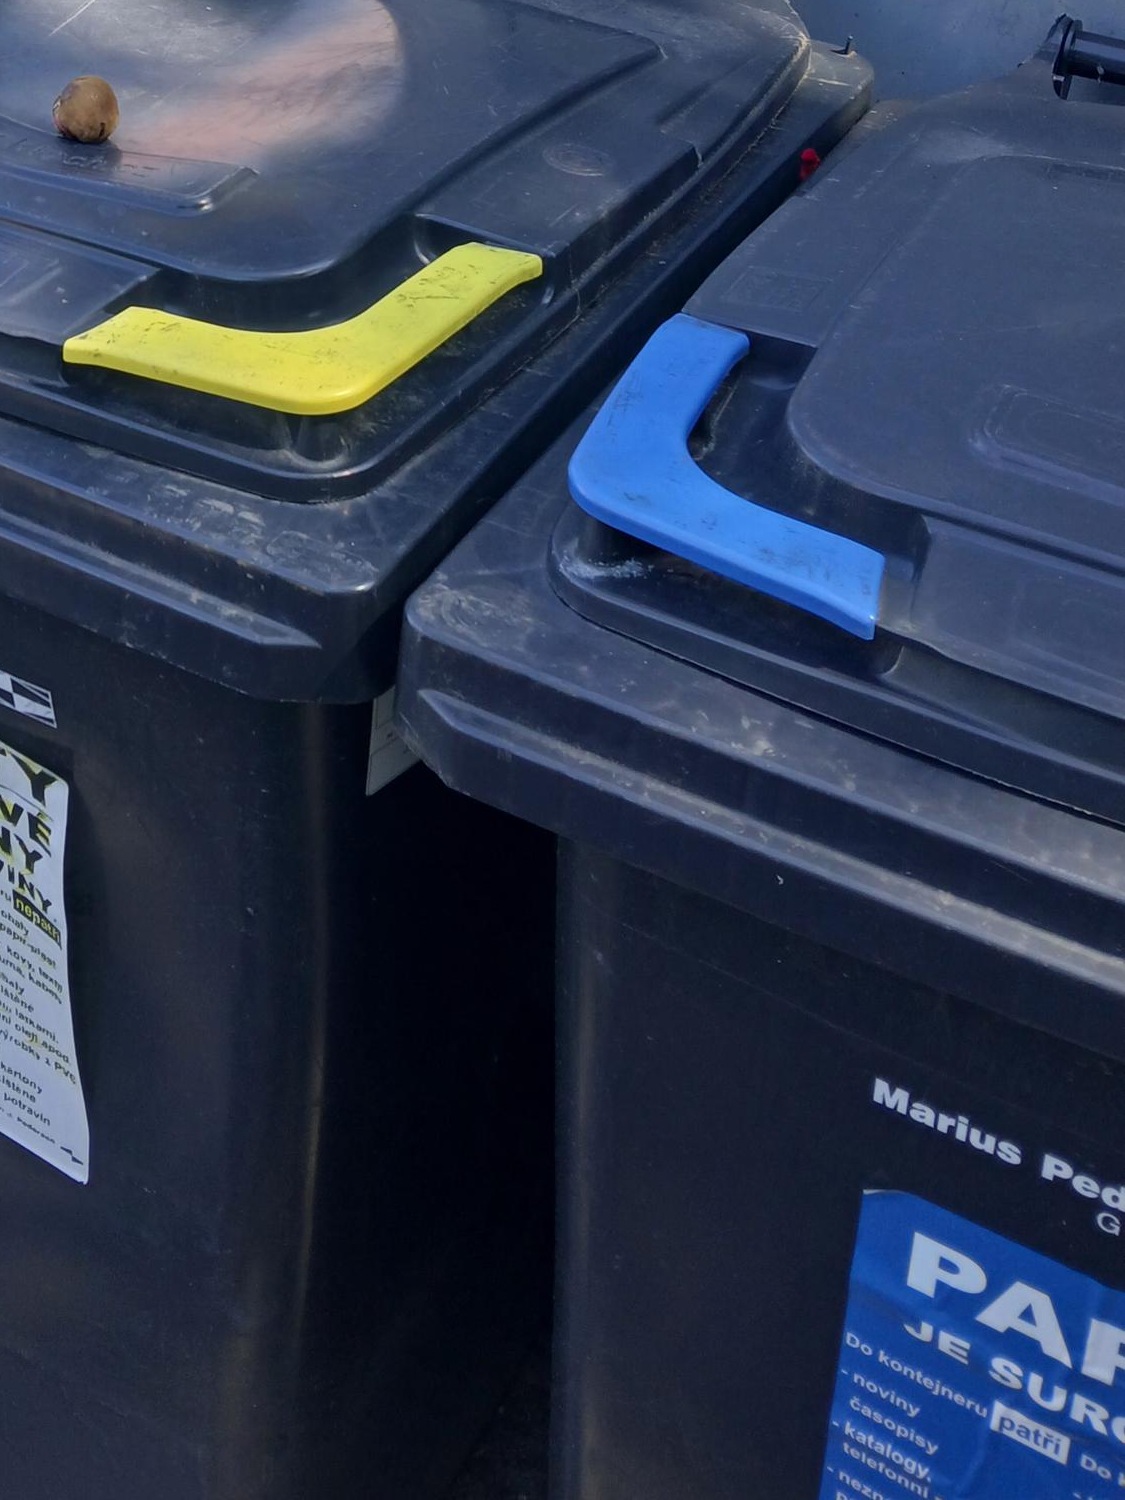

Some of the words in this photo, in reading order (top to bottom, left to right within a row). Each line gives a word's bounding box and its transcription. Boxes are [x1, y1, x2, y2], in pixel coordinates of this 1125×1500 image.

[873, 1078, 1022, 1165] Marius
[1041, 1153, 1125, 1212] Ped
[1096, 1212, 1121, 1237] G
[903, 1320, 972, 1365] JE
[845, 1331, 873, 1356] Do
[878, 1350, 987, 1418] kontejneru
[999, 1415, 1062, 1457] patří
[853, 1373, 921, 1418] noviny
[849, 1396, 939, 1455] časopisy
[1080, 1453, 1112, 1480] Do
